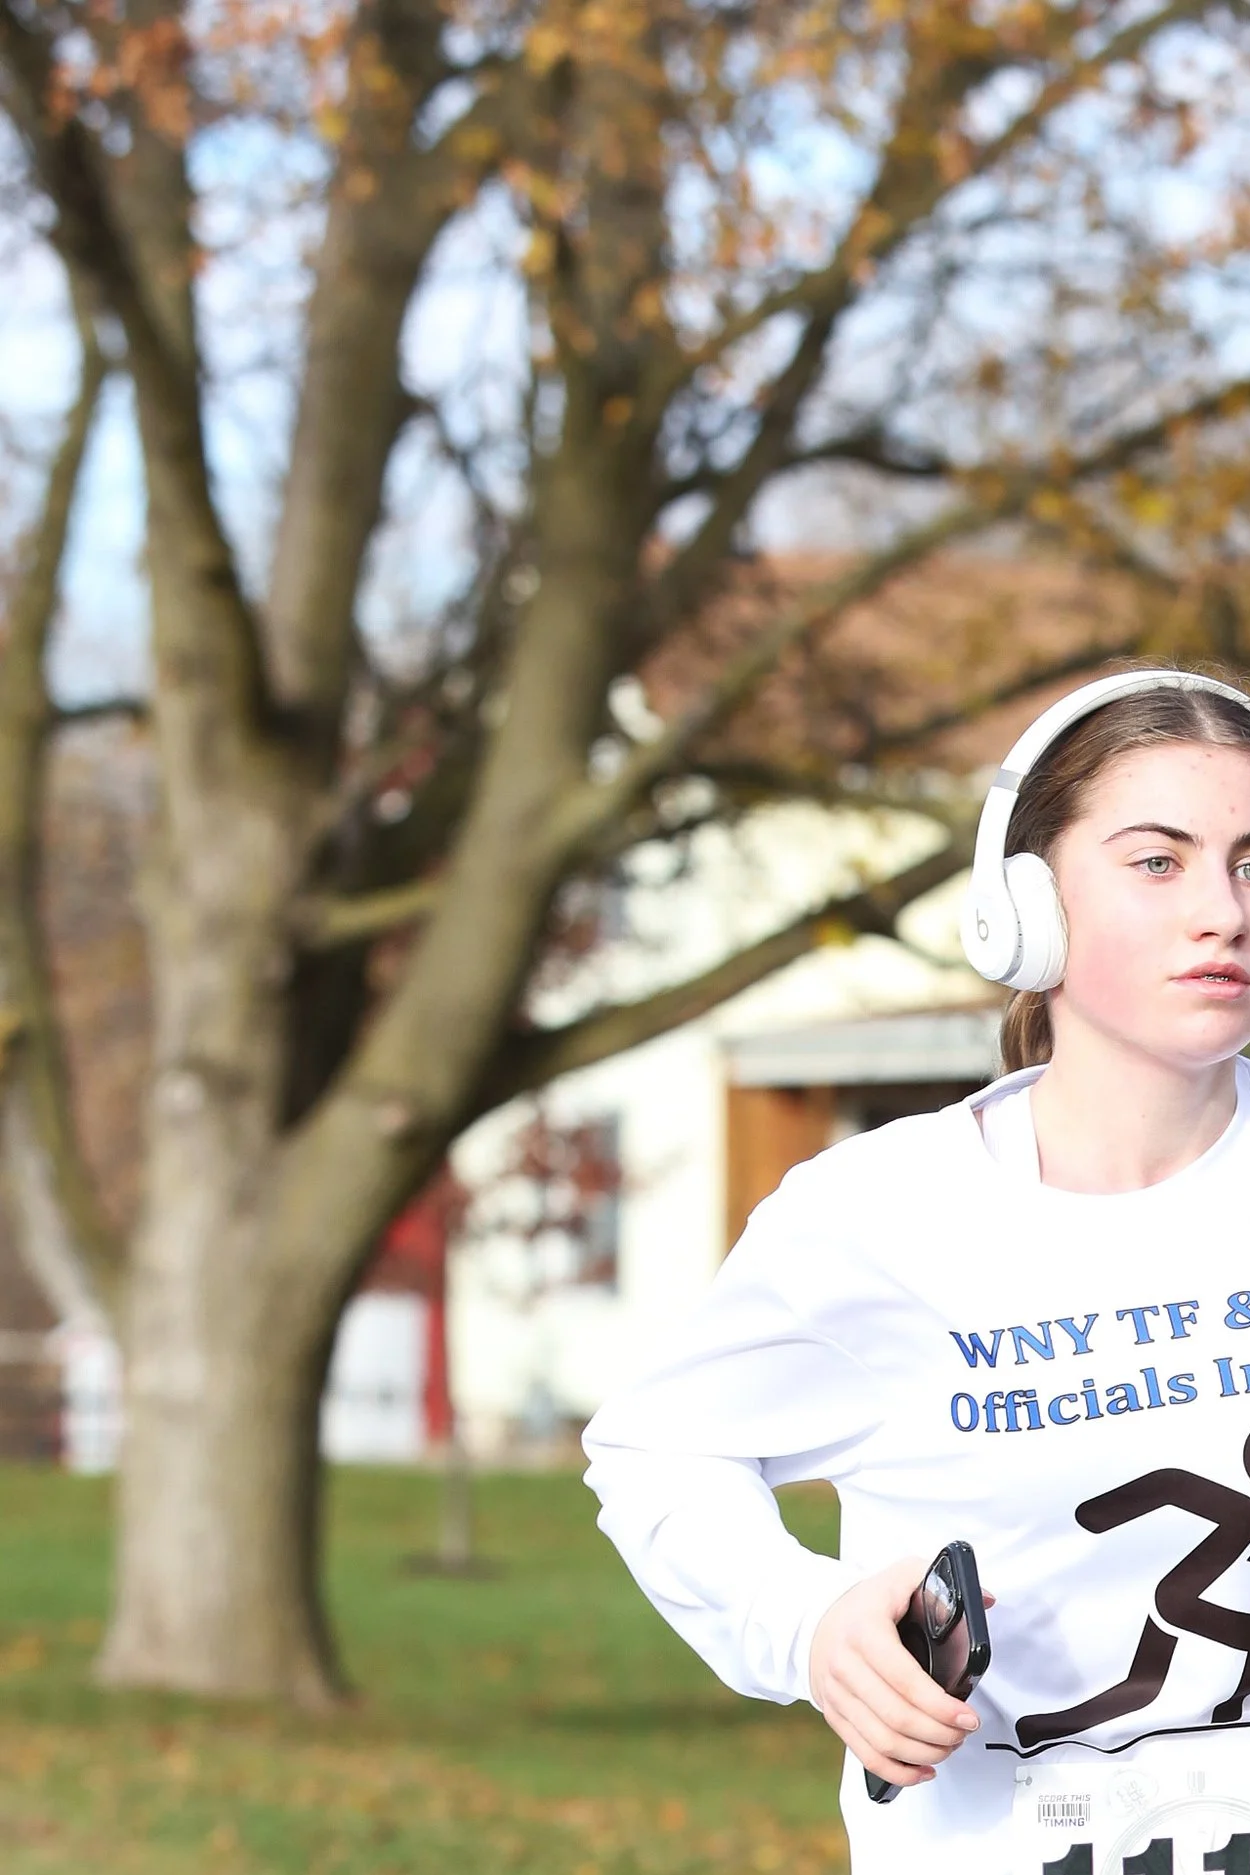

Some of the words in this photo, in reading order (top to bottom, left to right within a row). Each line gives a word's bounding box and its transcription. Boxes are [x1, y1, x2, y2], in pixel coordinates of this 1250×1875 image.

[949, 1313, 1099, 1368] WNY
[1116, 1300, 1200, 1345] TF
[1038, 1794, 1068, 1803] SCORE
[1071, 1793, 1091, 1802] THIS
[1043, 1818, 1085, 1827] TIMING
